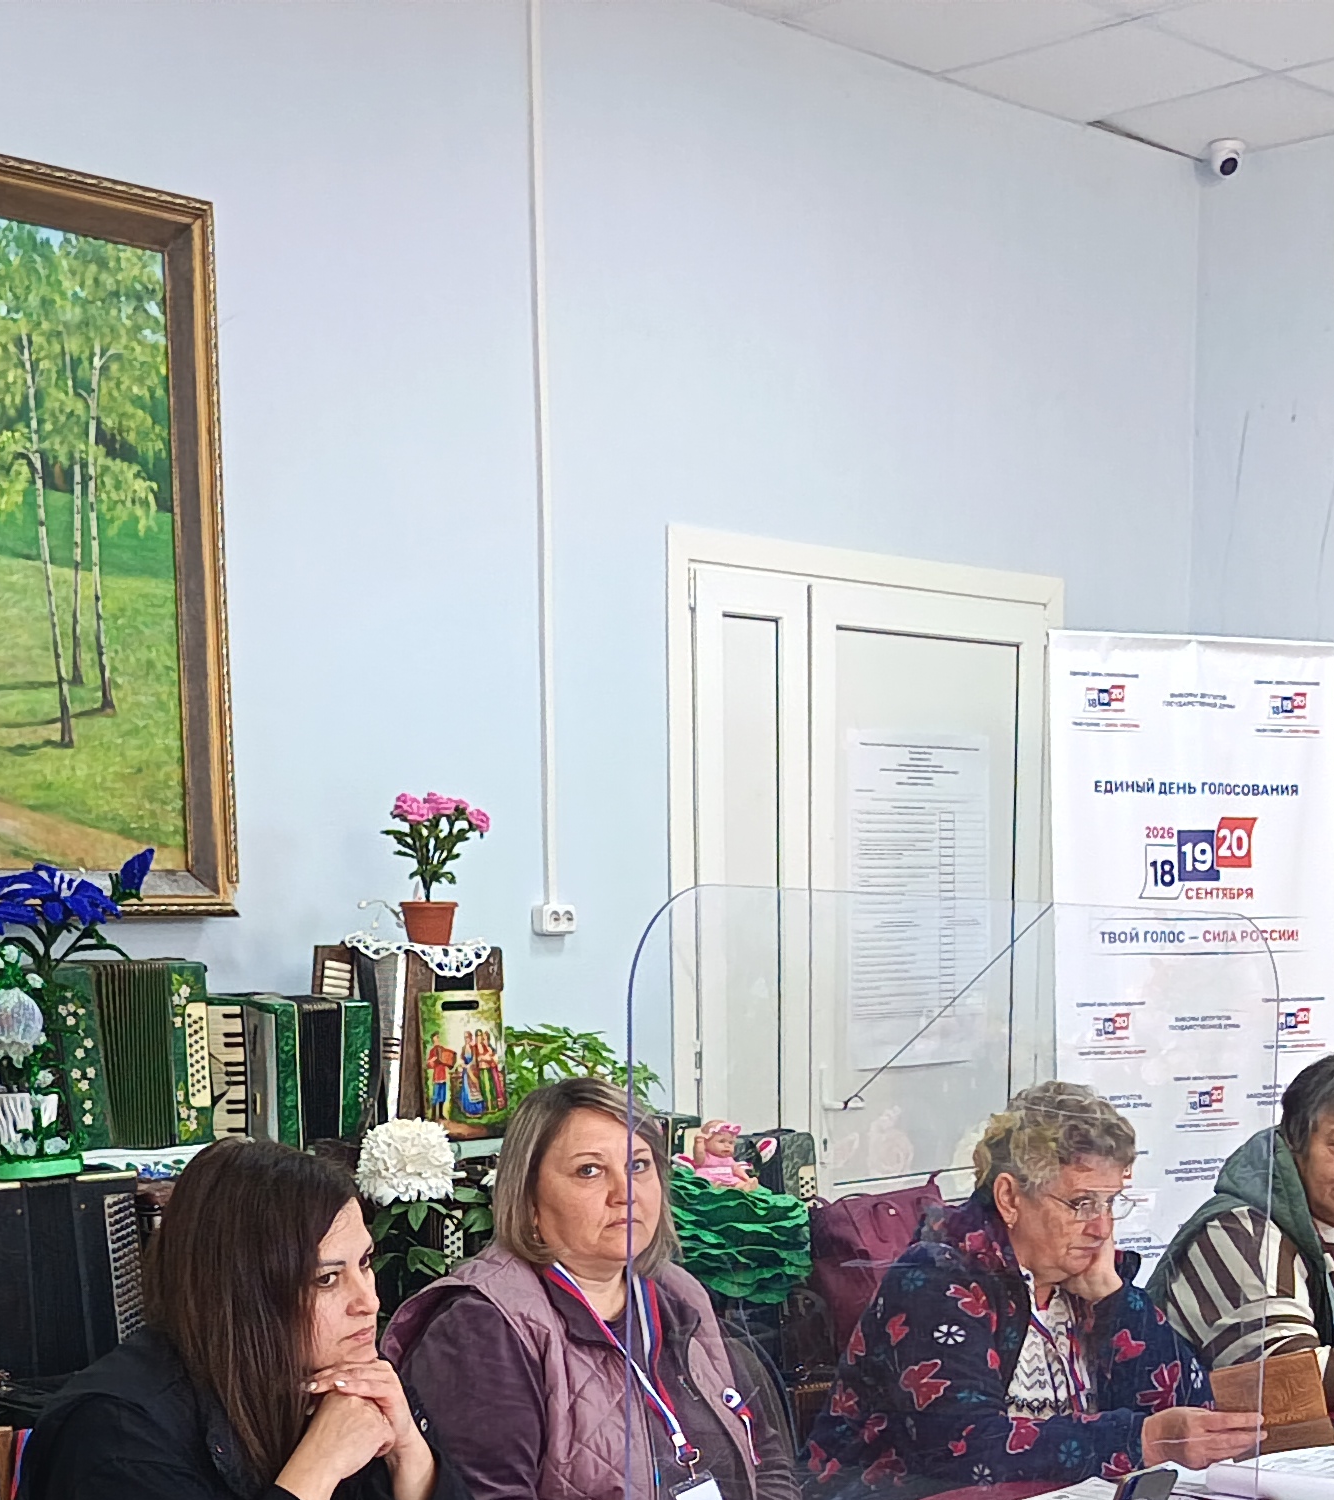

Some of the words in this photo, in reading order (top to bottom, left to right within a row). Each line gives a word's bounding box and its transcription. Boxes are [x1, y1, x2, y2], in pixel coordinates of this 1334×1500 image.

[1094, 778, 1155, 795] ЕДИНЫЙ
[1158, 782, 1197, 796] ДЕНЬ
[1201, 782, 1299, 797] ГОЛОСОВАНИЯ
[1145, 827, 1174, 839] 2026
[1149, 859, 1175, 887] 18
[1181, 842, 1213, 872] 19
[1217, 829, 1249, 857] 20
[1185, 887, 1254, 900] СЕНТЯБРЯ
[1100, 928, 1139, 944] ТВОЙ
[1143, 930, 1185, 944] ГОЛОС
[1203, 930, 1238, 943] СИЛА
[1241, 929, 1299, 943] РОССИИ!
